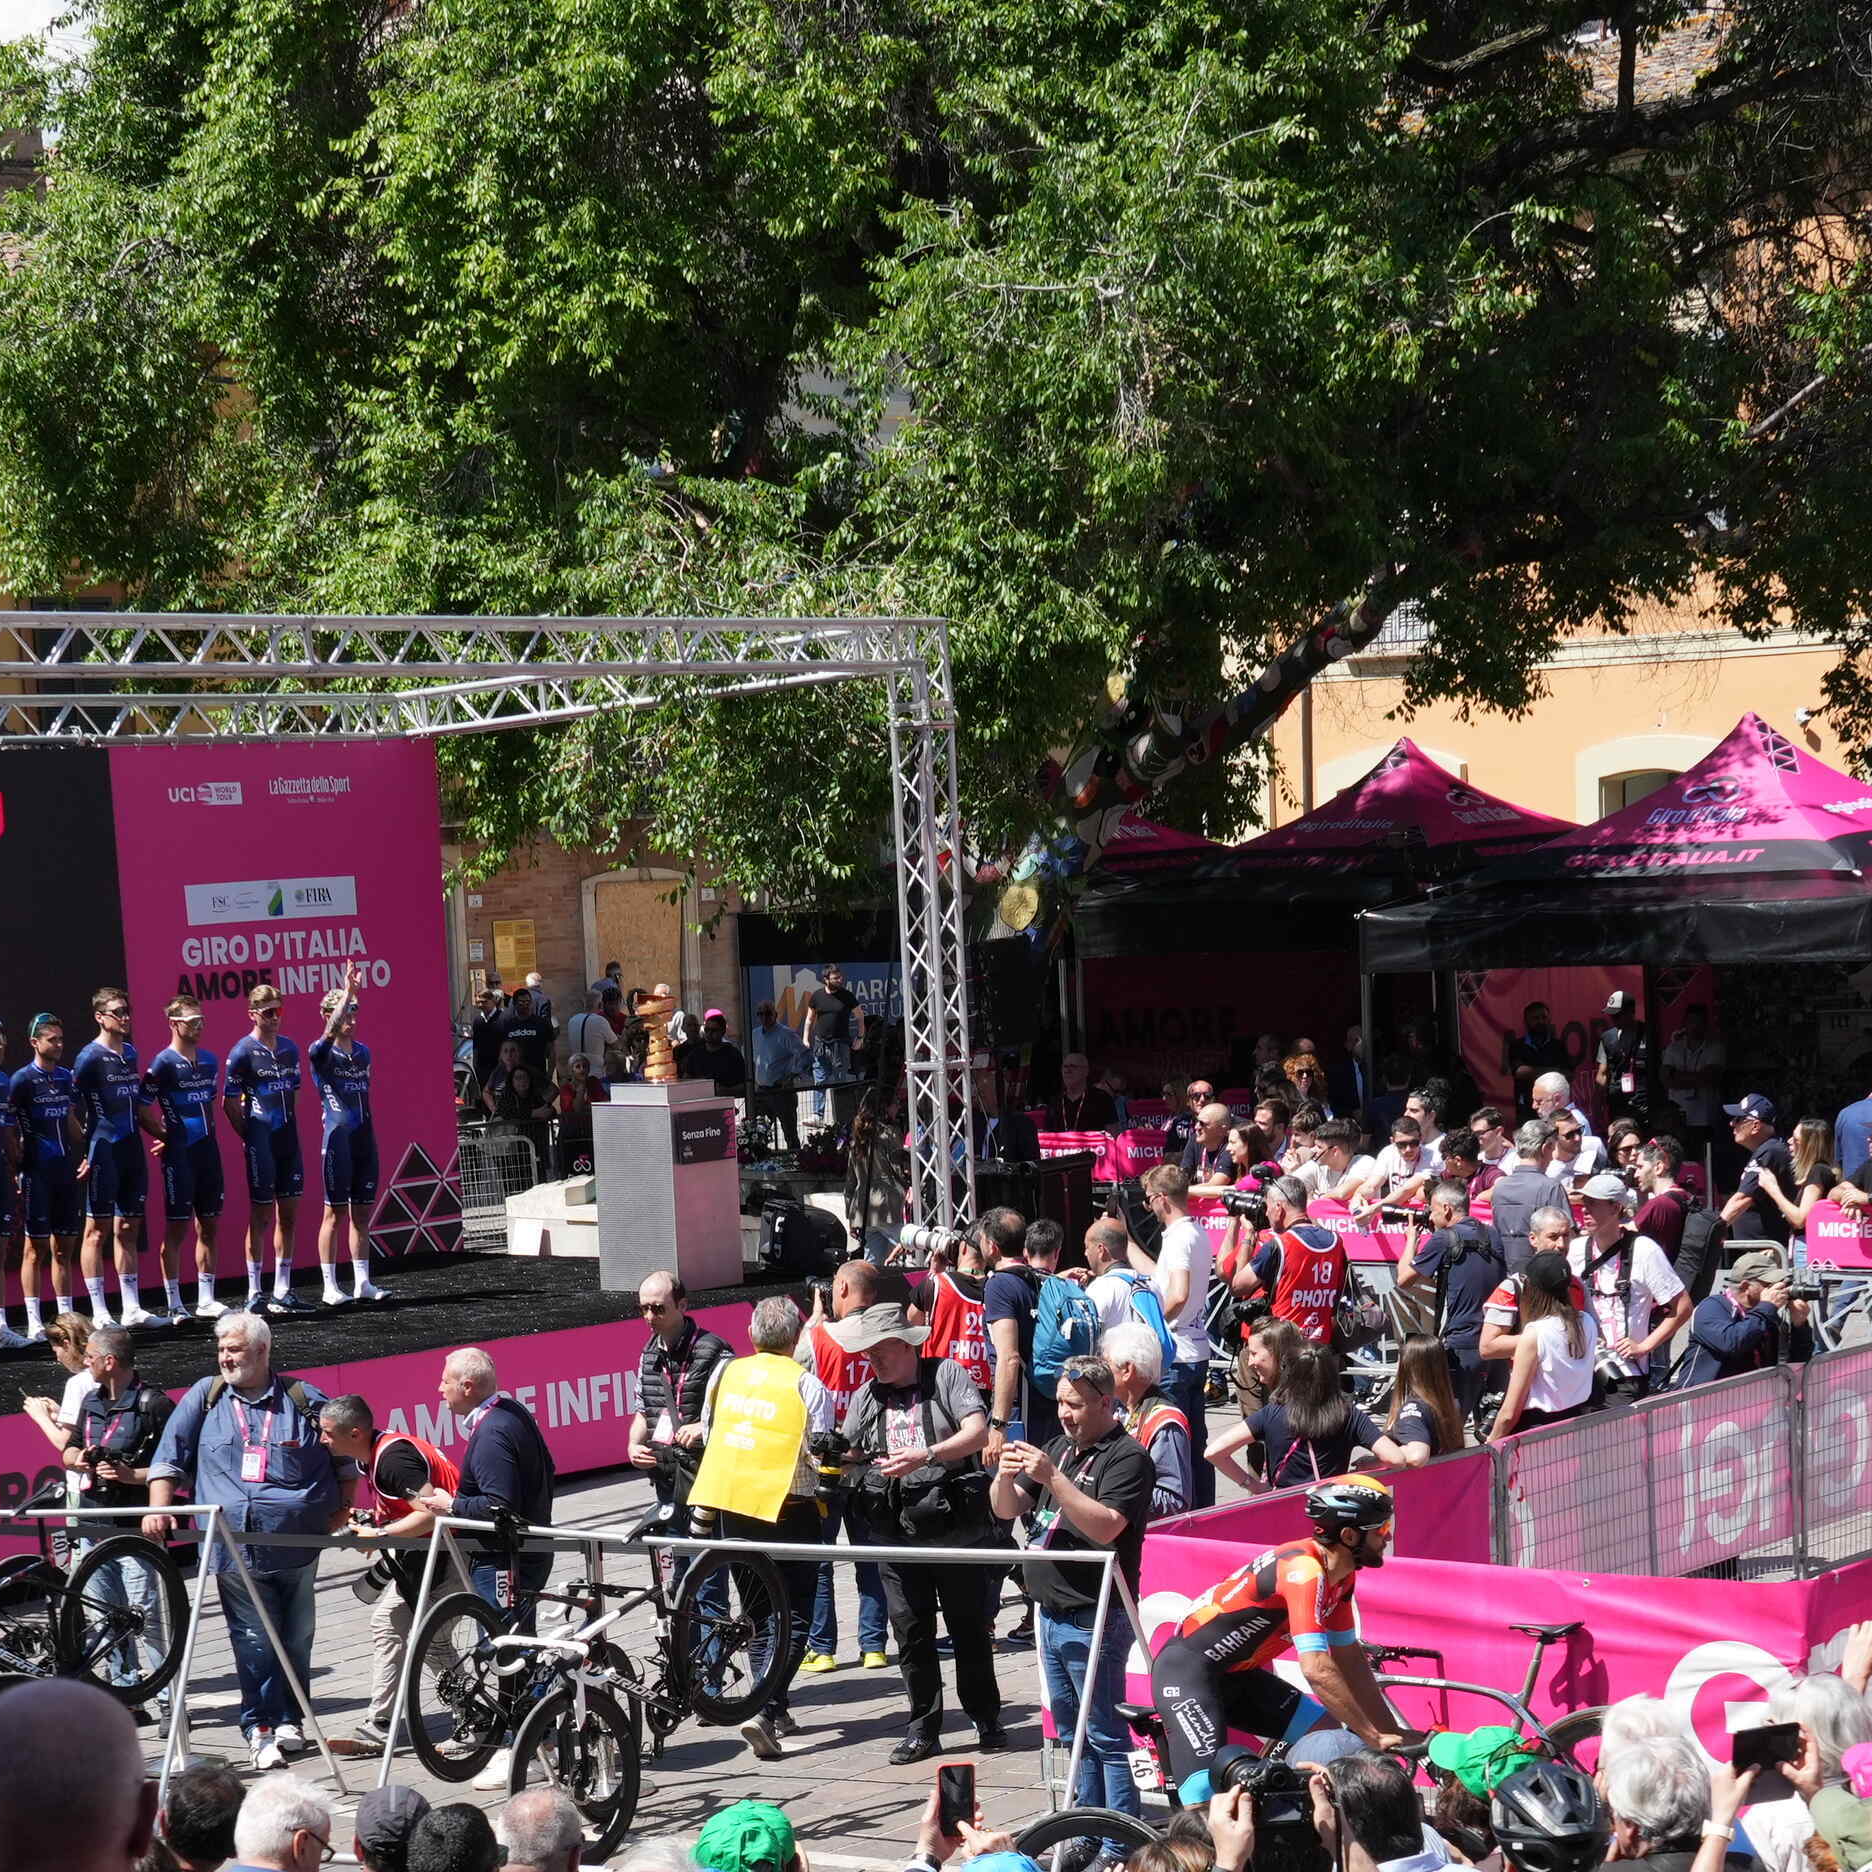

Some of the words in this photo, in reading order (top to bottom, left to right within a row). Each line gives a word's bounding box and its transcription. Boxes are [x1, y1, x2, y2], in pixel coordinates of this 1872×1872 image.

[168, 787, 196, 803] UCI
[268, 779, 278, 795] La
[278, 777, 311, 794] Gazzetta
[311, 777, 329, 793] dello
[329, 775, 352, 795] Sport
[1294, 817, 1394, 833] #giroditalia
[1646, 807, 1689, 826] Giro
[1690, 804, 1748, 824] d'Italia
[304, 887, 333, 904] FIRA
[182, 935, 250, 968] GIRO
[254, 927, 368, 963] D'ITALIA
[278, 959, 392, 996] INFINTO
[507, 1029, 537, 1039] adidas
[681, 1127, 702, 1140] Senza
[704, 1126, 721, 1138] Fine
[1311, 1261, 1333, 1284] 18
[949, 1339, 988, 1360] PHOT
[845, 1360, 870, 1385] 17
[387, 1385, 539, 1448] AME
[721, 1393, 776, 1420] PHOTO
[660, 1553, 674, 1570] 42
[497, 1574, 508, 1599] 105
[1203, 1616, 1272, 1662] BAHRAIN
[1171, 1697, 1217, 1757] friendly
[1131, 1756, 1154, 1779] 46
